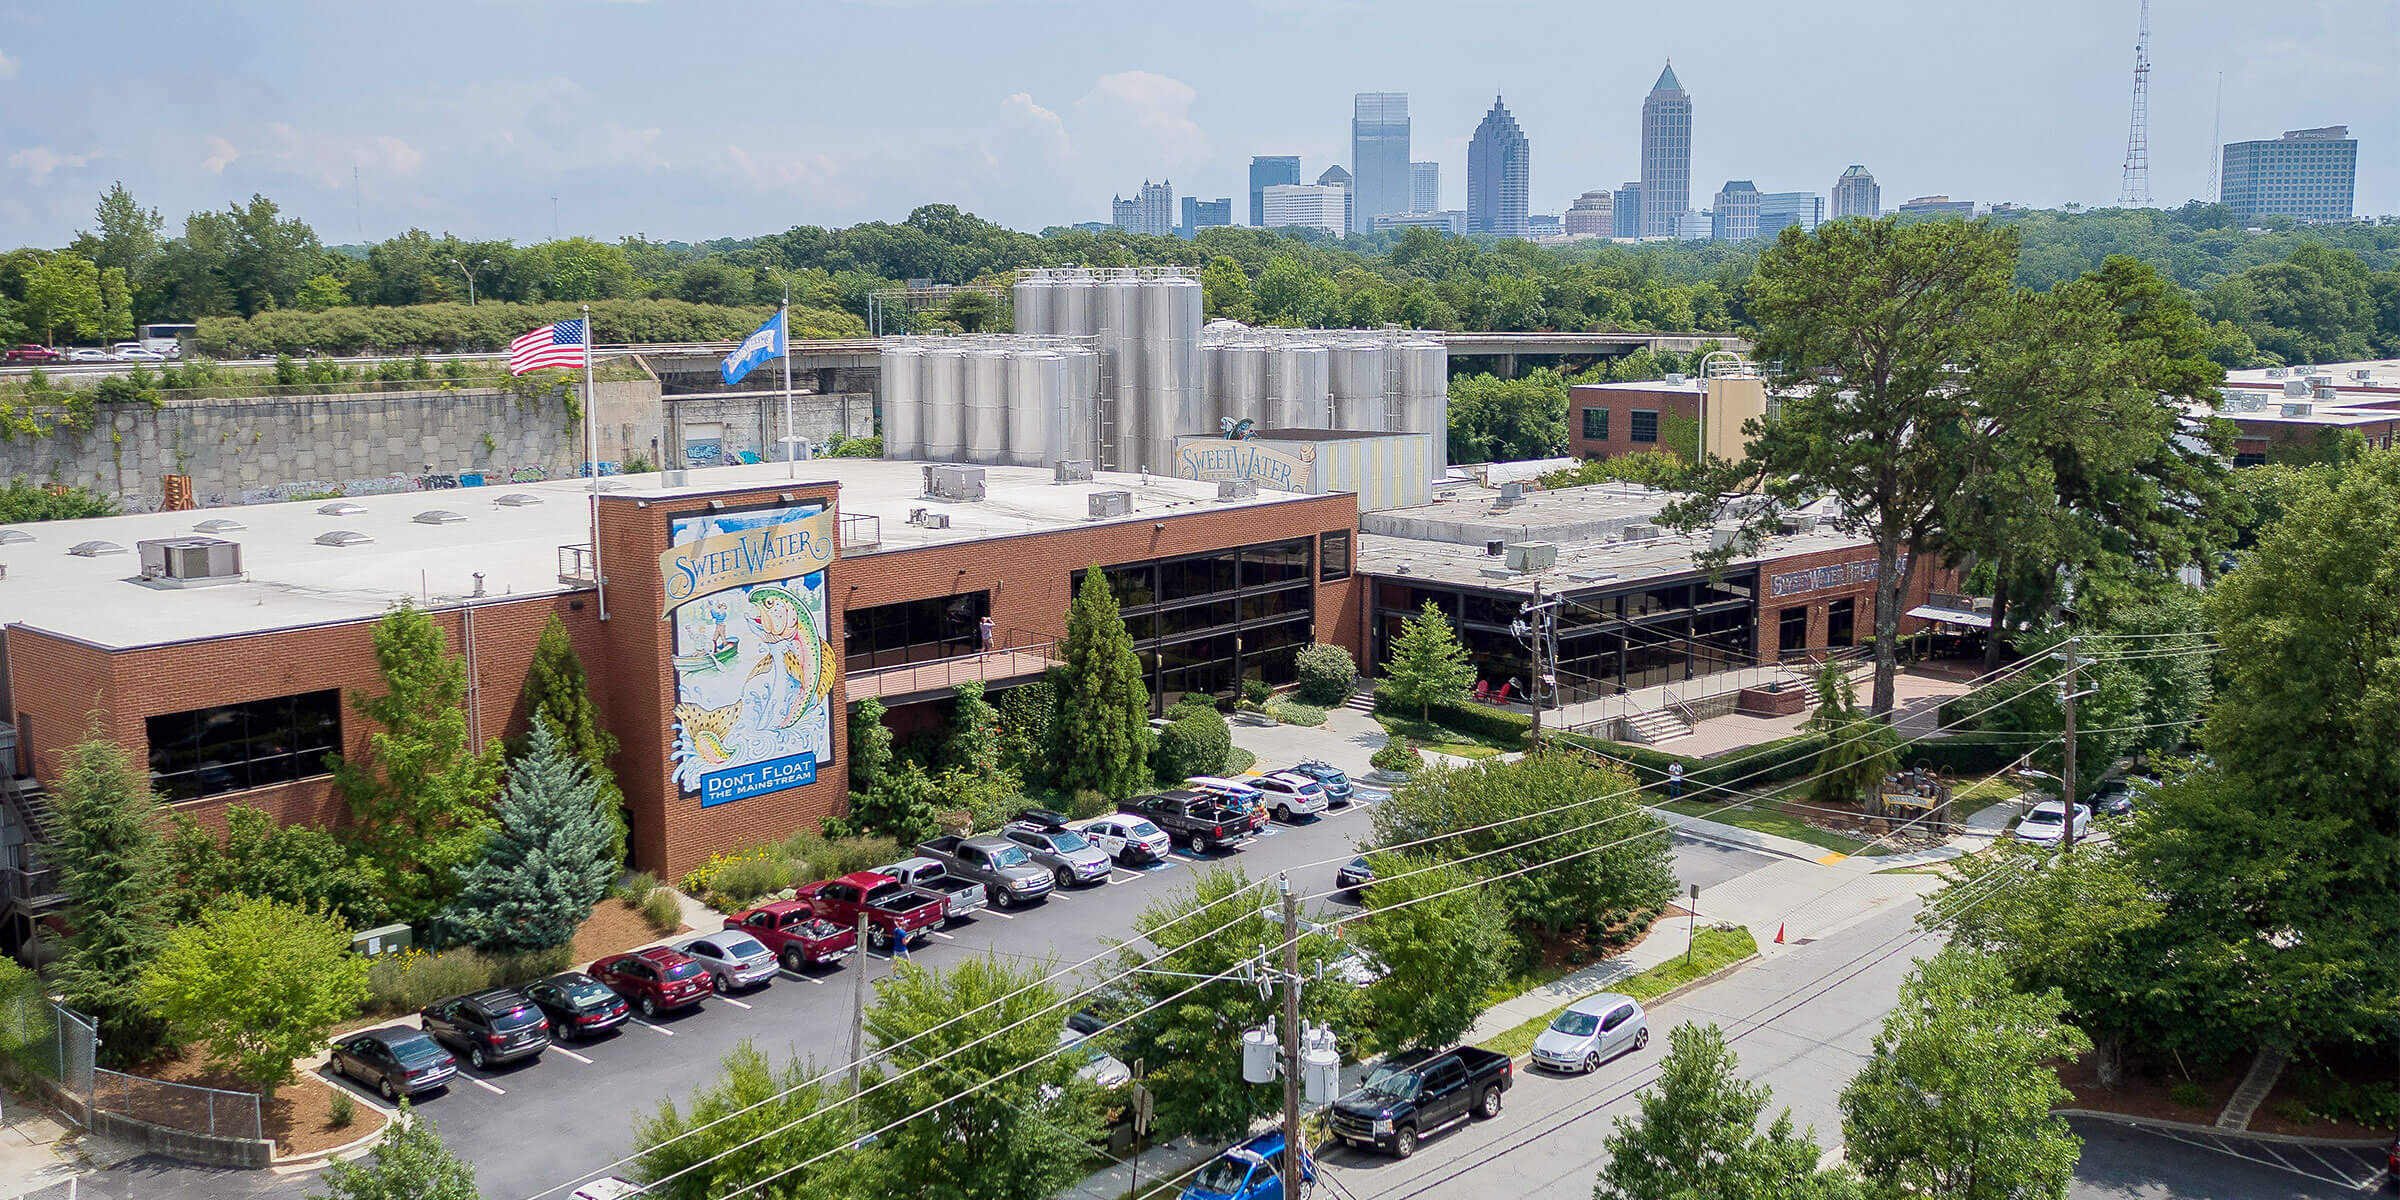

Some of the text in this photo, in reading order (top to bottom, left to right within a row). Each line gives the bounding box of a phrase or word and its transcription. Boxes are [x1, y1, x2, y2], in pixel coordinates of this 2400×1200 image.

[708, 760, 812, 792] DON'T FLOAT
[709, 771, 811, 800] THE MAINSTREAM
